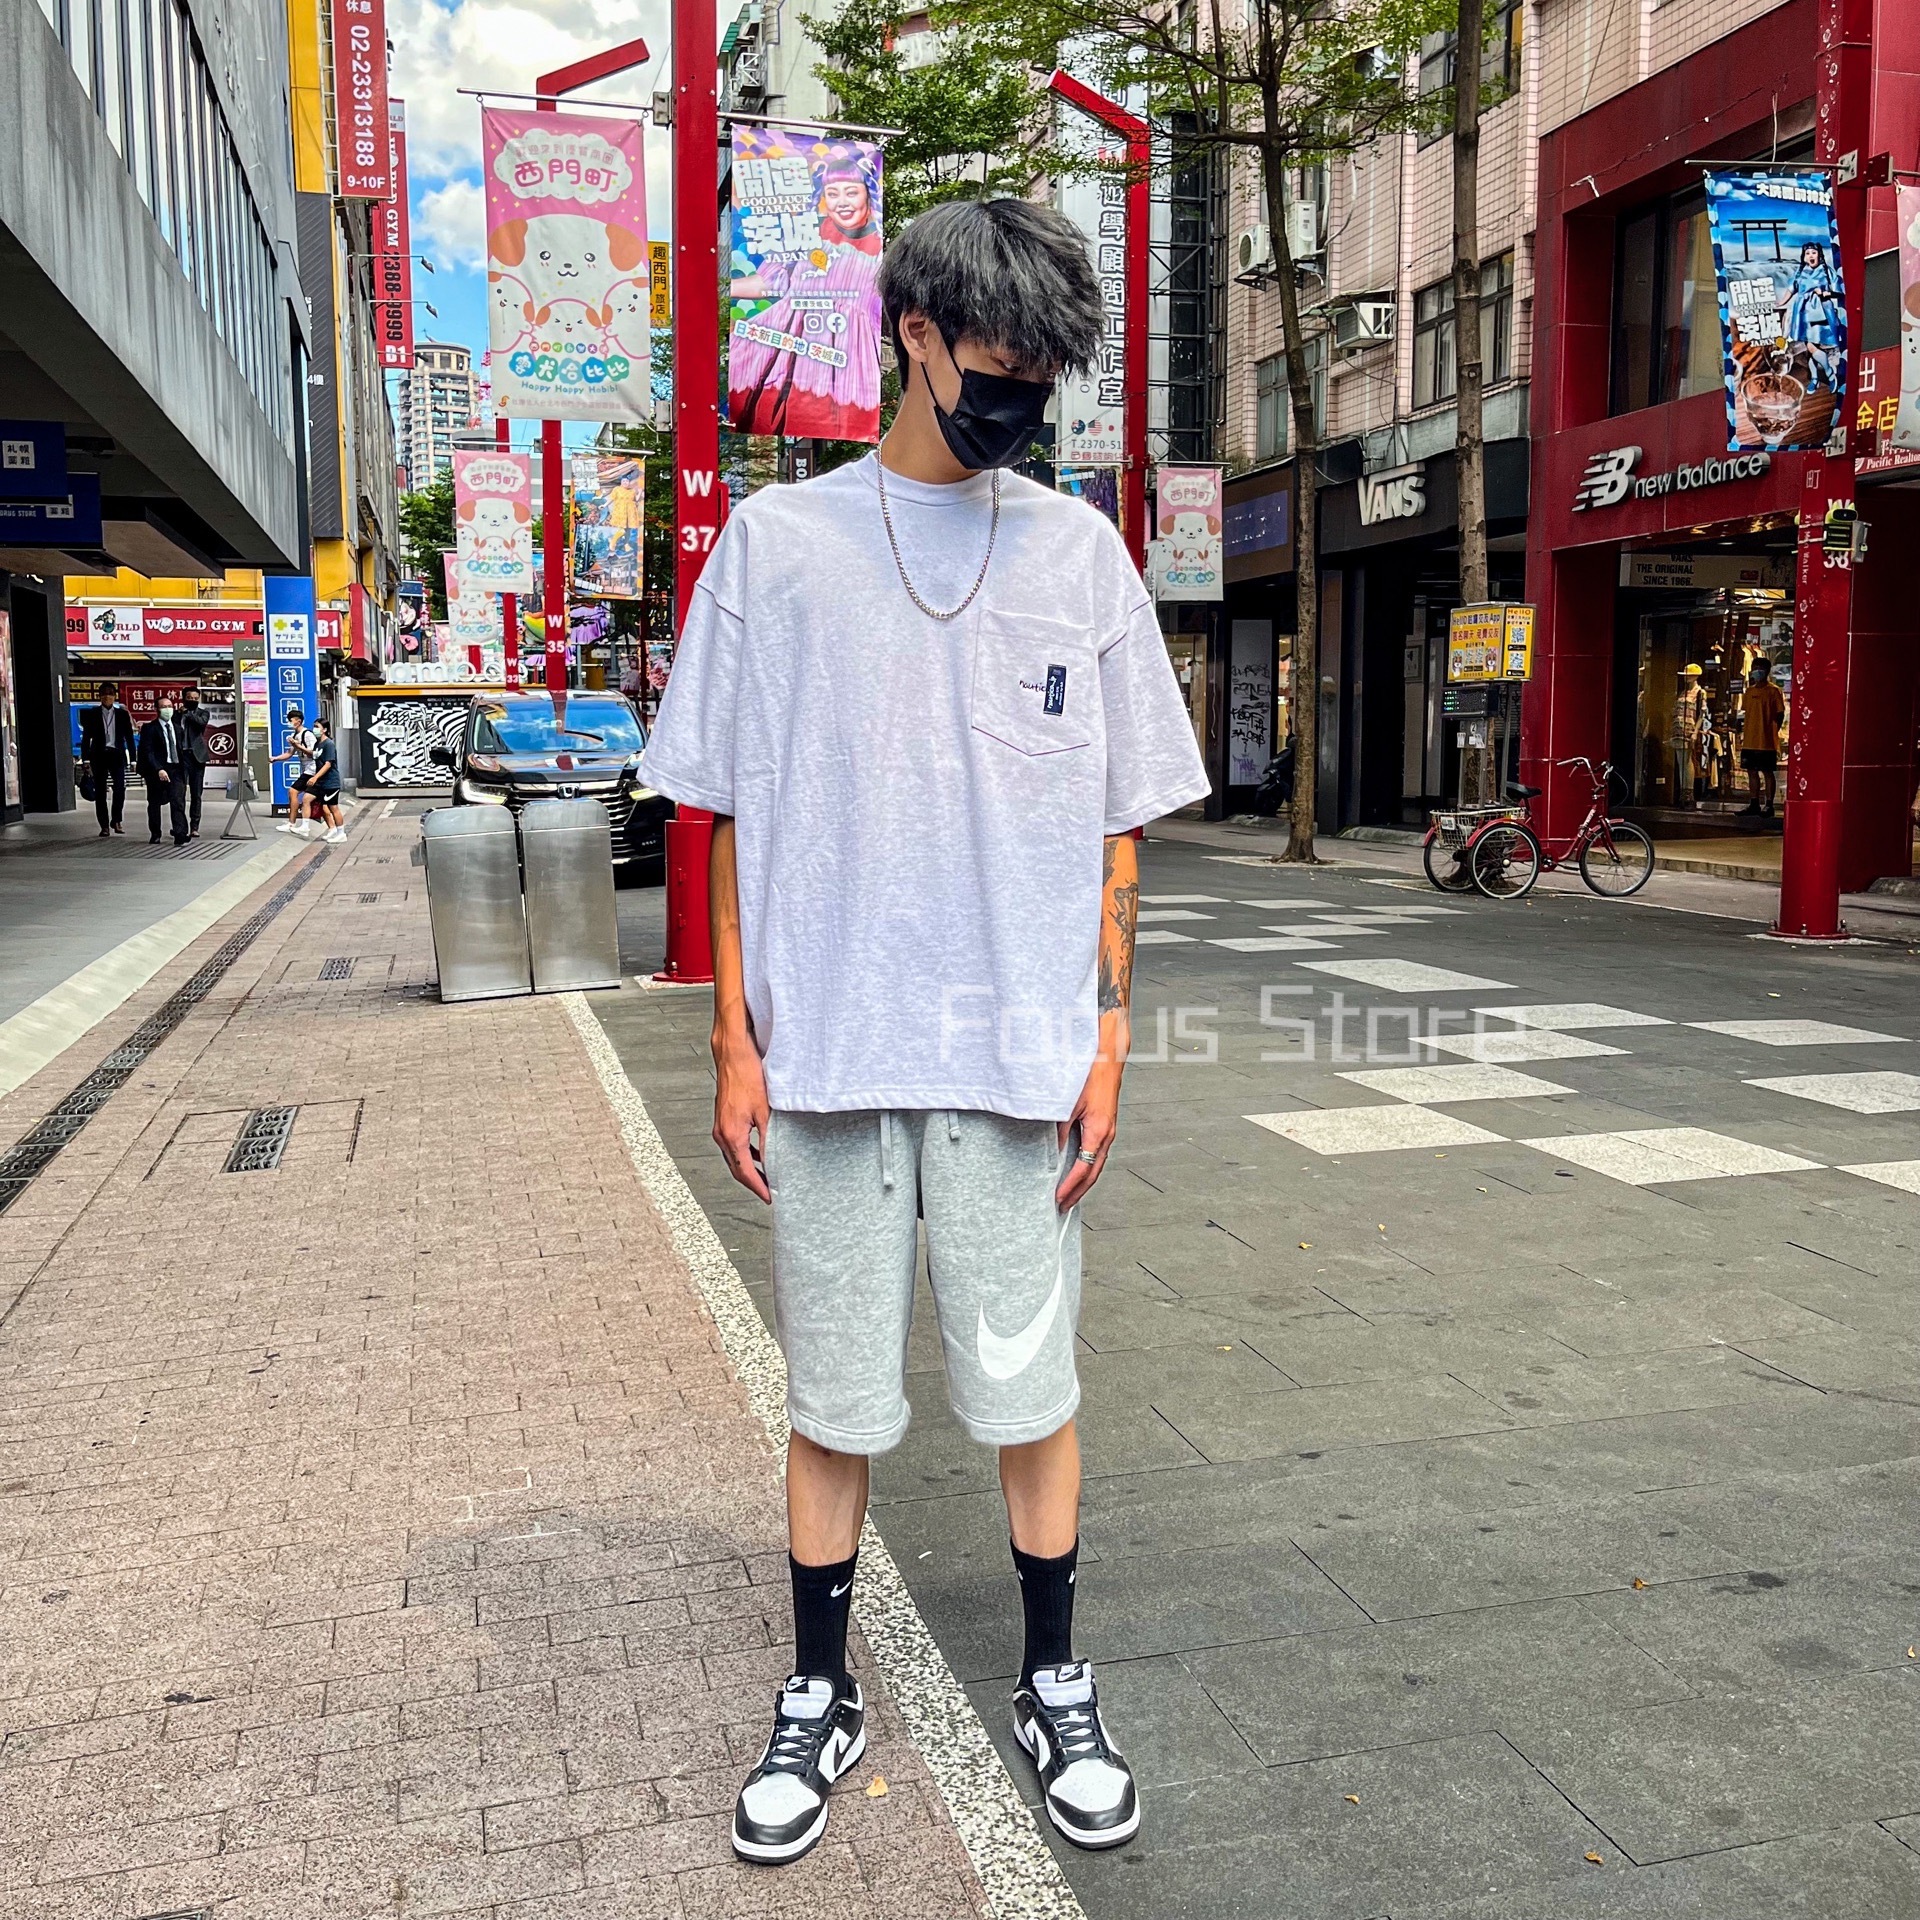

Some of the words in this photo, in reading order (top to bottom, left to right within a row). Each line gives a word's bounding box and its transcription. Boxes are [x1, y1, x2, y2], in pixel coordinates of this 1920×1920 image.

[350, 25, 376, 167] 02-23313188
[347, 175, 386, 188] 9-10F
[514, 158, 618, 192] 西門町
[740, 197, 778, 207] GOOD
[778, 193, 812, 204] LUCK
[751, 204, 807, 215] IBARAKI
[386, 208, 399, 247] GYM
[766, 251, 808, 263] JAPAN
[653, 246, 667, 290] 趣西門
[655, 294, 666, 314] 旅店
[736, 321, 808, 353] 日本新目的地
[811, 344, 845, 365] 茨城縣
[521, 380, 551, 393] Happy
[555, 384, 585, 394] Happy
[588, 384, 618, 394] Habibi
[795, 458, 808, 483] BO
[1866, 456, 1893, 470] Pacific
[470, 471, 518, 487] 西門町
[682, 469, 714, 498] W
[1635, 472, 1672, 499] new
[1677, 454, 1768, 491] balance
[1170, 487, 1212, 502] 西門町
[1357, 462, 1425, 526] VANS
[681, 524, 716, 553] 37
[1636, 563, 1653, 573] THE
[1655, 564, 1694, 574] ORIGINAL
[1643, 575, 1668, 586] SINCE
[145, 617, 207, 634] WORLD
[211, 620, 246, 631] GYM
[317, 619, 339, 638] B1
[547, 614, 563, 628] W
[101, 633, 131, 642] GYM
[547, 640, 565, 653] 35
[506, 657, 518, 667] W
[506, 674, 519, 684] 33
[132, 689, 155, 700] 住宿
